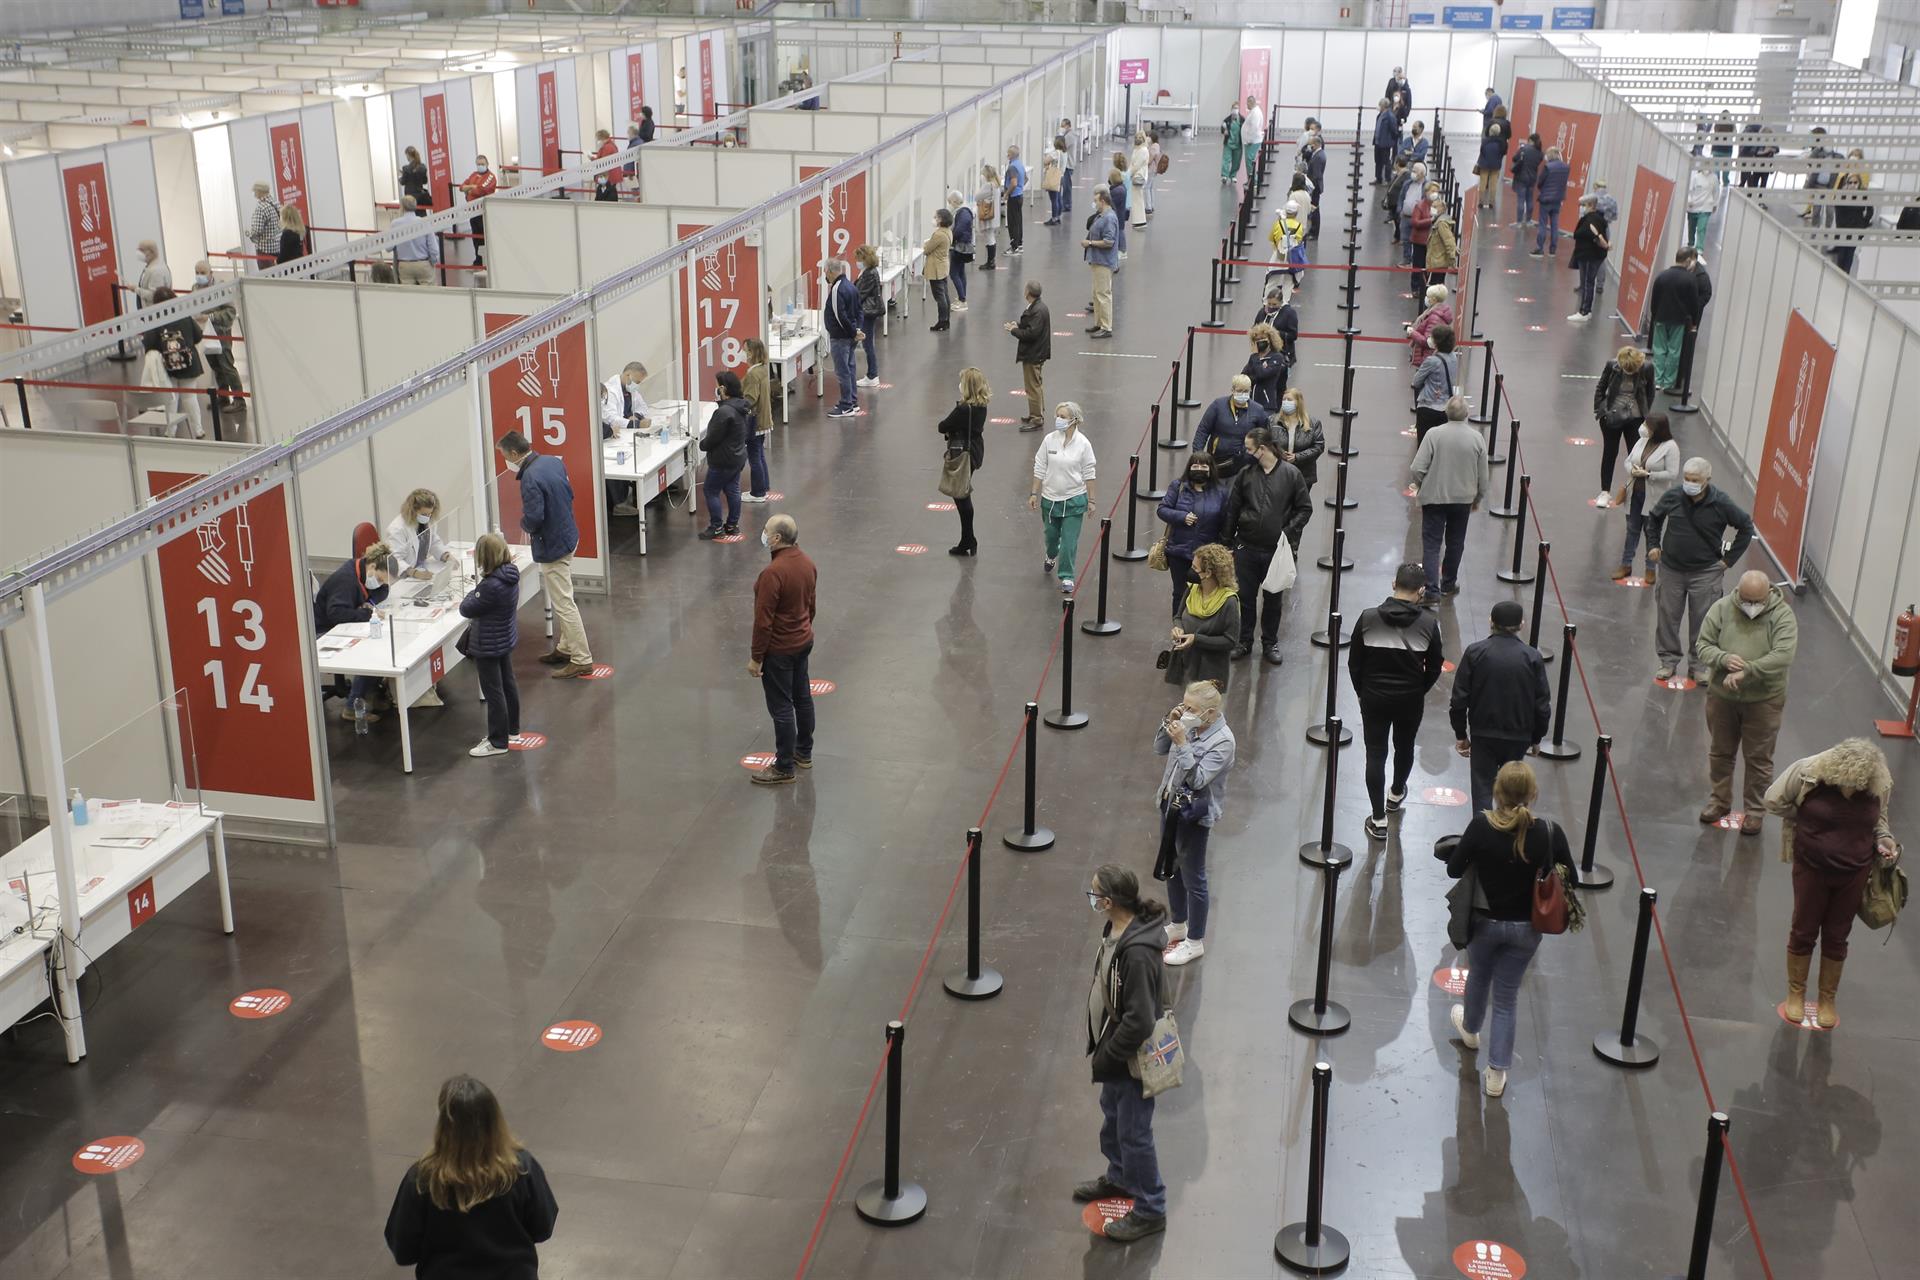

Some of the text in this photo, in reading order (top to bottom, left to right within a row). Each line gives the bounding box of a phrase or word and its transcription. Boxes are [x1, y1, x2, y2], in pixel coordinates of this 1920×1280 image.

[700, 297, 740, 329] 17
[700, 336, 741, 368] 18
[516, 405, 567, 446] 15
[197, 597, 267, 651] 13
[433, 656, 442, 673] 15
[203, 659, 274, 713] 14
[134, 892, 150, 915] 14
[1477, 1264, 1510, 1274] DISTANCIA
